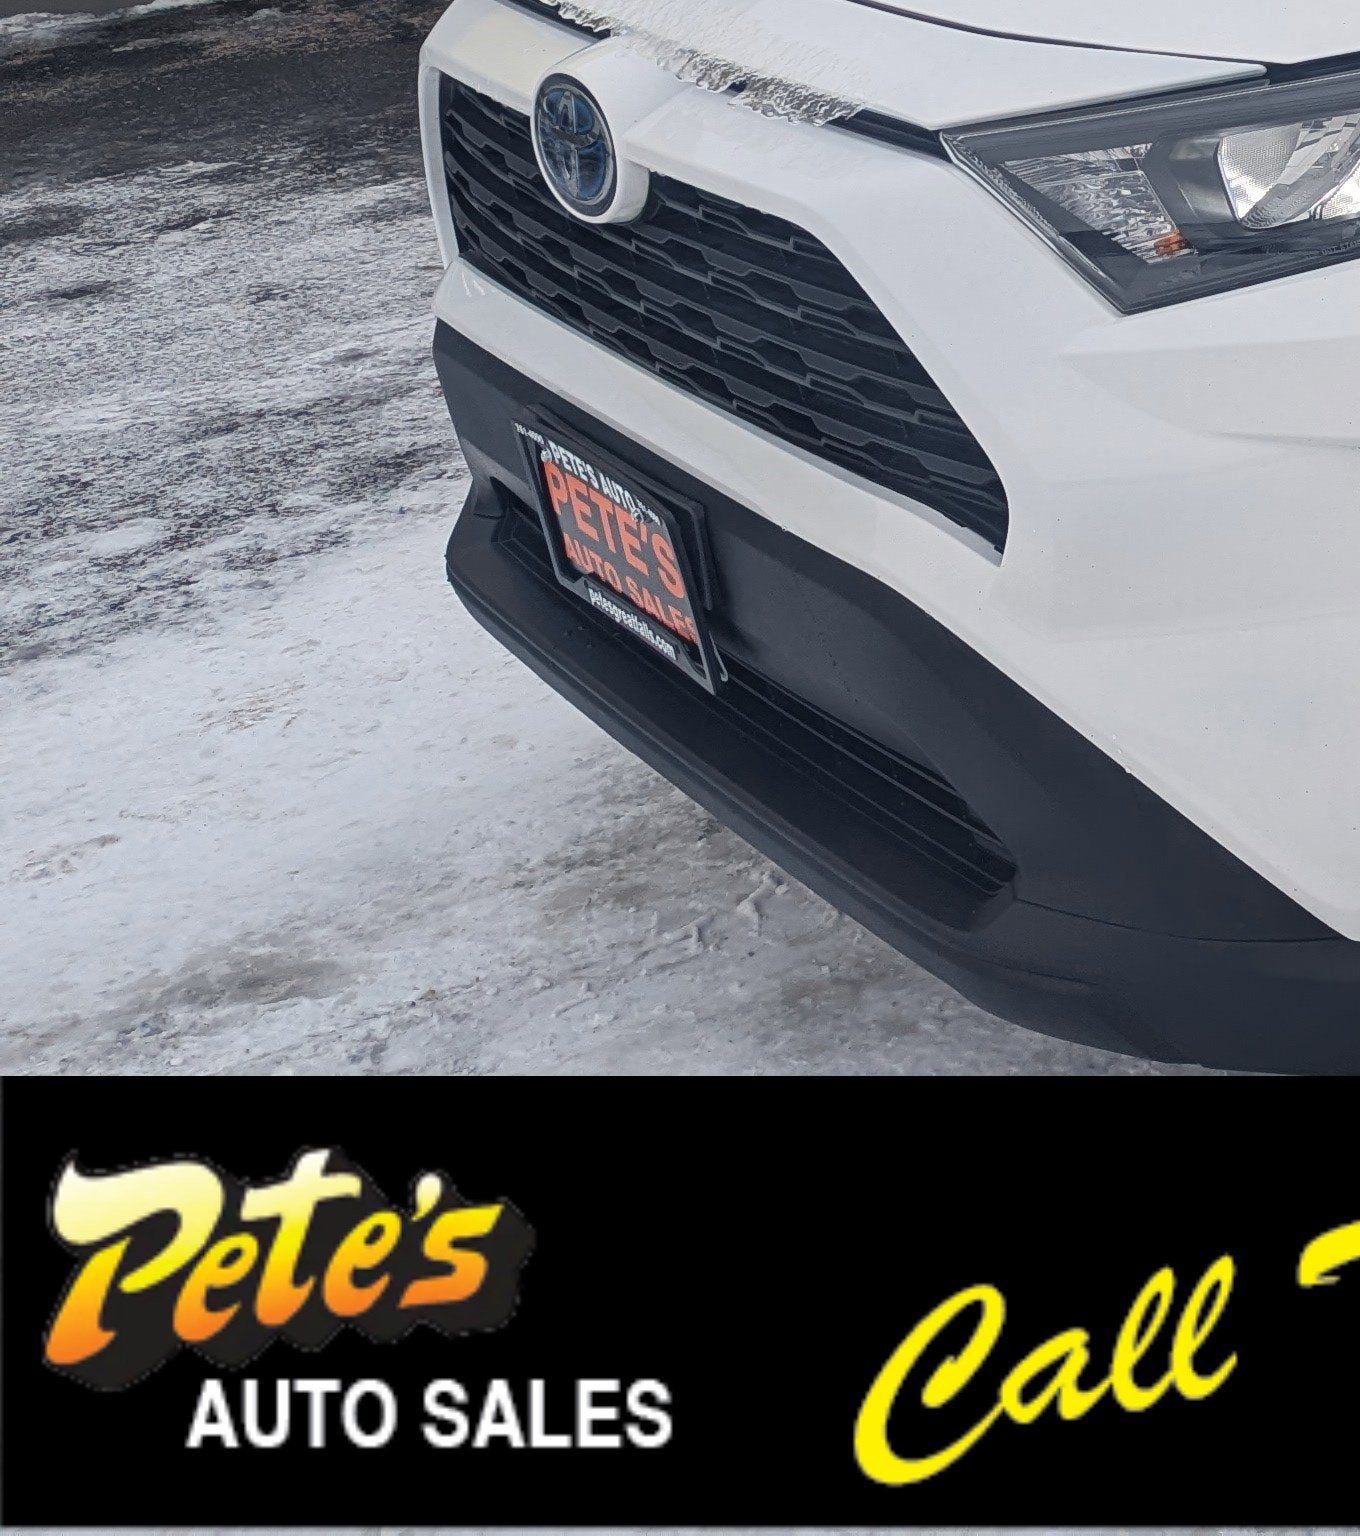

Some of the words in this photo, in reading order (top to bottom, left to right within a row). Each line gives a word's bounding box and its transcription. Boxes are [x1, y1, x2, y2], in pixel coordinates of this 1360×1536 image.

[548, 440, 600, 489] PETE'S
[544, 461, 684, 599] PETE'S
[563, 531, 624, 594] AUTO
[625, 575, 700, 646] SALES
